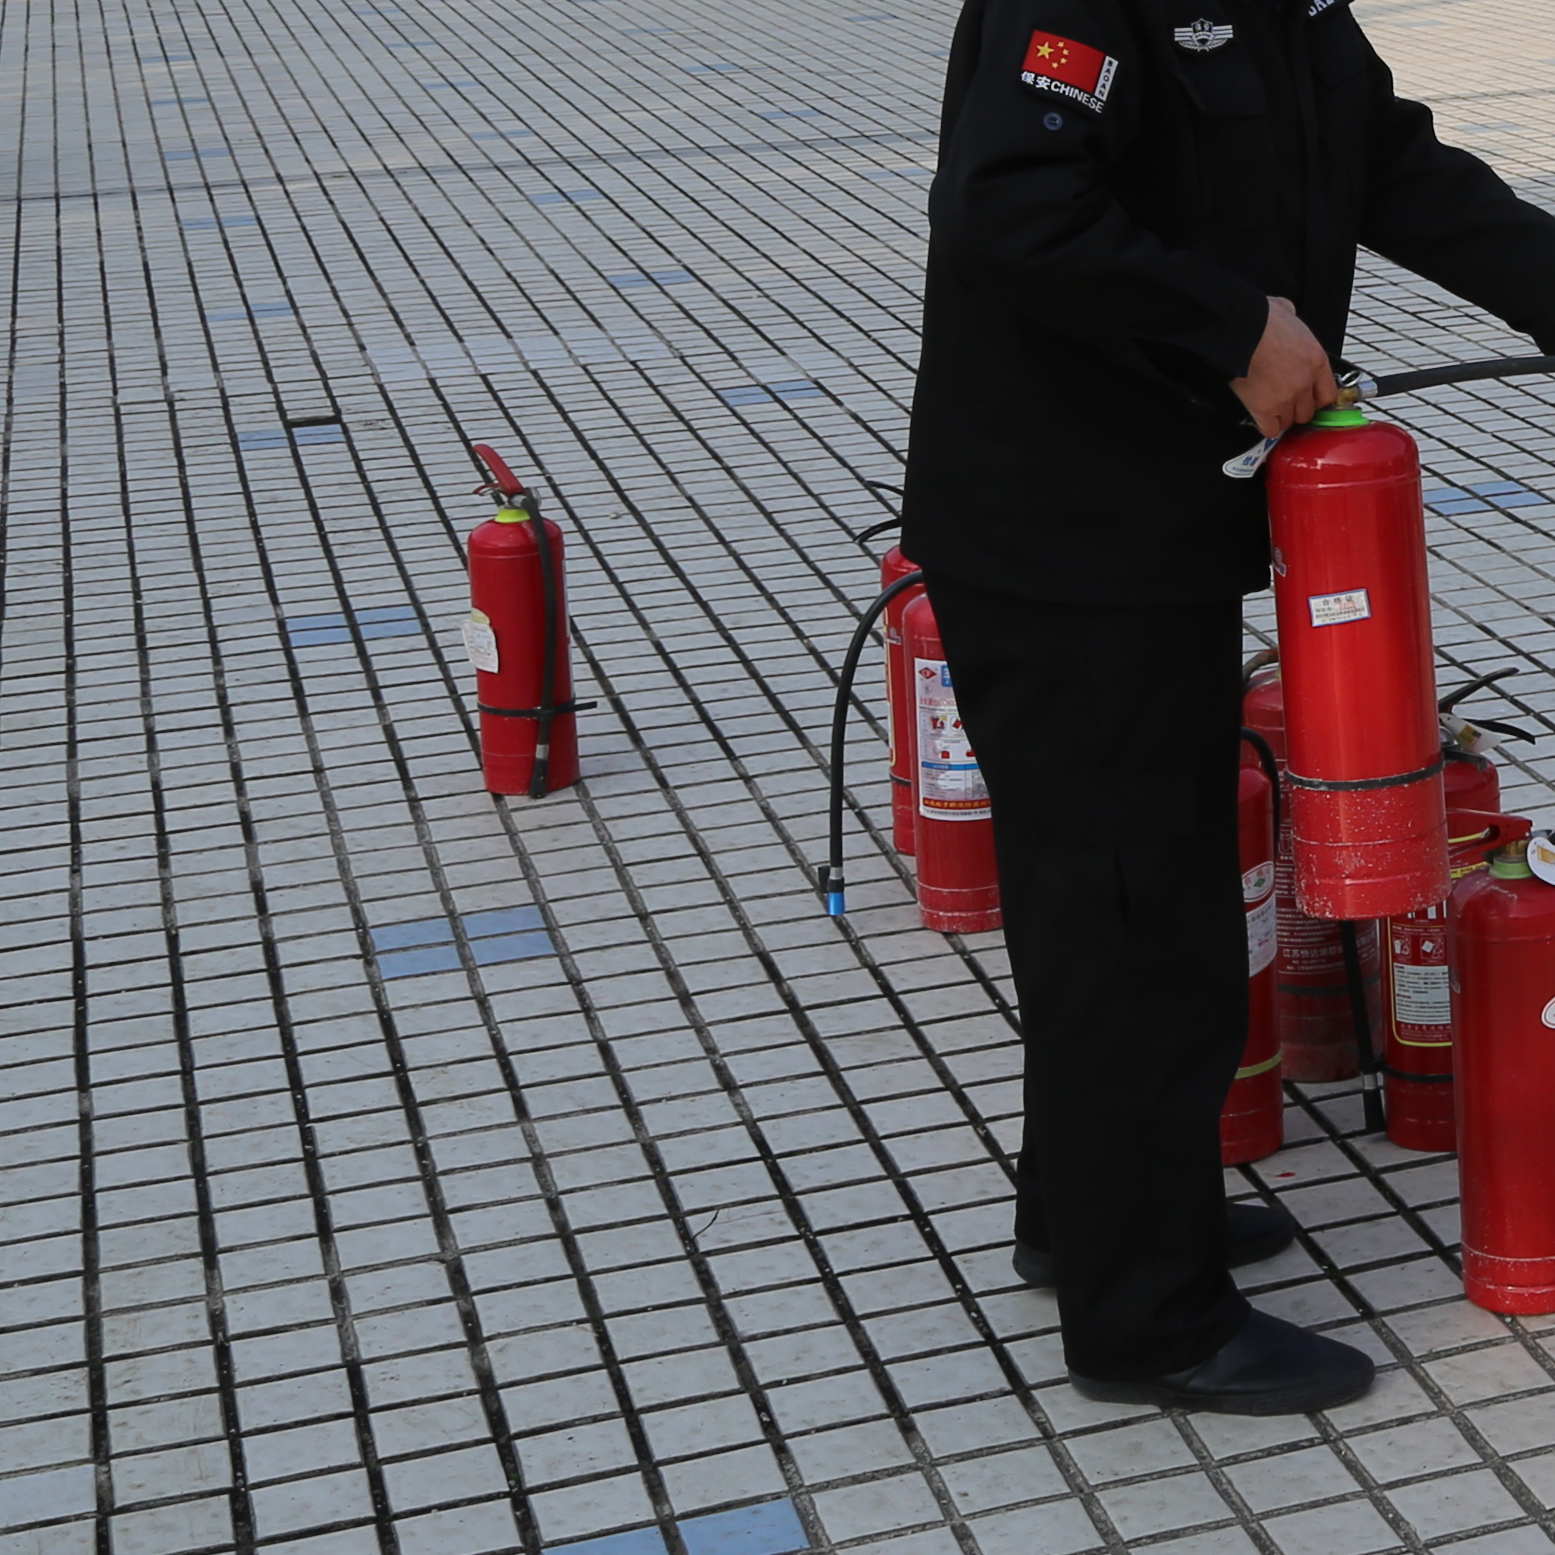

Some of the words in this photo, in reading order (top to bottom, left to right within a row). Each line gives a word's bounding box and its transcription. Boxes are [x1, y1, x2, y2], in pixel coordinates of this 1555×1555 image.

[1021, 71, 1051, 90] 保安
[1050, 81, 1105, 113] CHINESE
[1100, 60, 1113, 97] BAOAN
